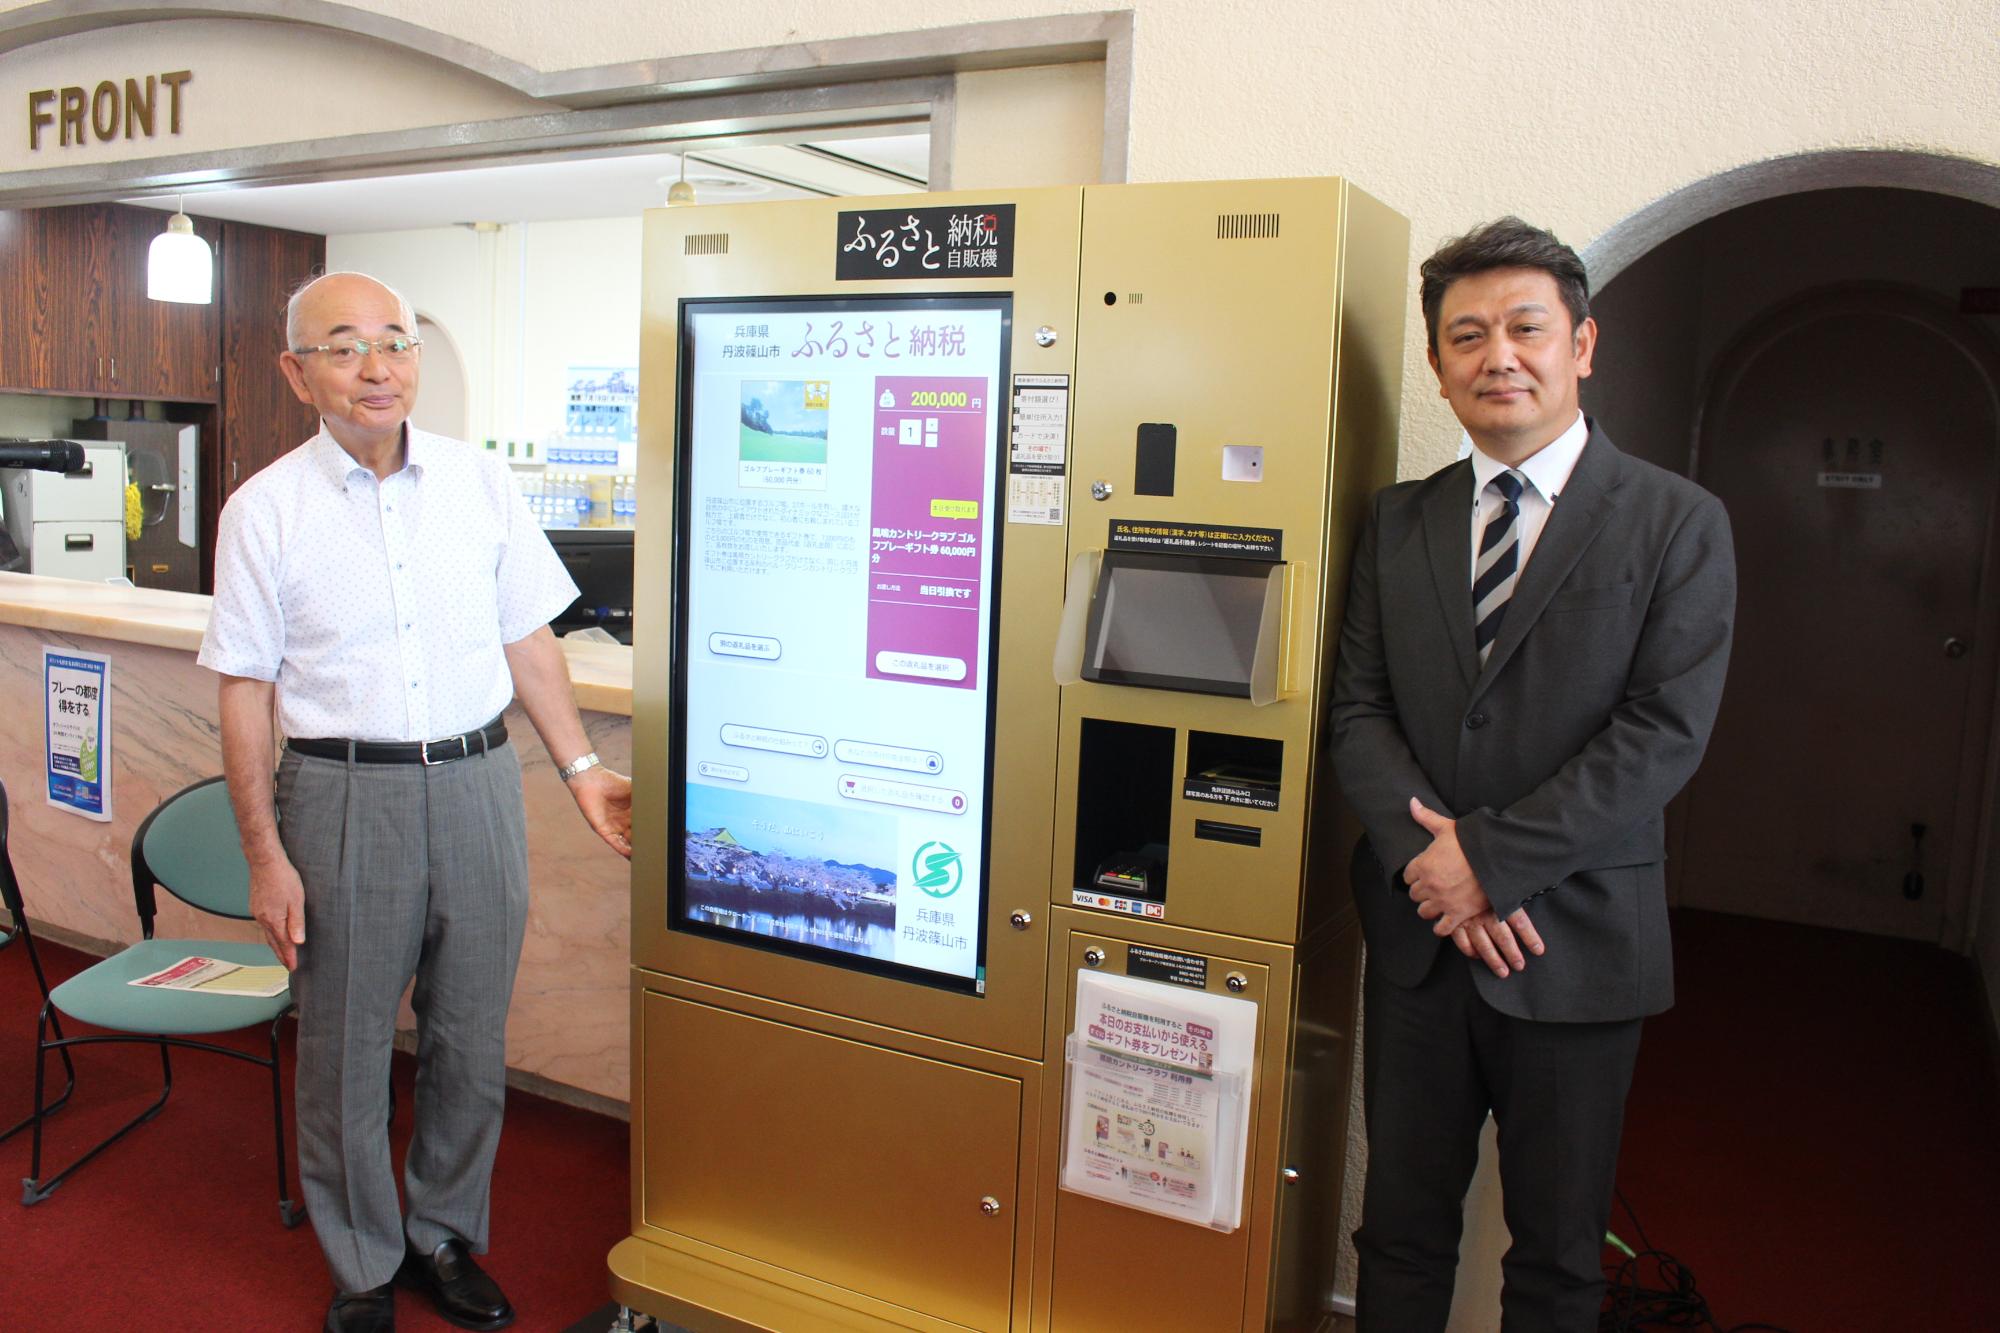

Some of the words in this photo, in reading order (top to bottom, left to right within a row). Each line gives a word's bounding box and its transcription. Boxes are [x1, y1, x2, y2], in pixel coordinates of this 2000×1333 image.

[29, 70, 192, 150] FRONT
[947, 249, 998, 269] 自販機
[734, 325, 769, 339] 兵庫県
[791, 321, 966, 358] ふるさと納税
[721, 344, 781, 359] 丹波篠山市
[911, 391, 967, 408] 200,000
[972, 399, 982, 409] 円
[907, 426, 914, 438] 1
[872, 554, 880, 563] 分
[58, 699, 90, 717] 得をする
[1076, 894, 1093, 904] VISA
[916, 908, 956, 928] 兵庫県
[903, 927, 969, 951] 丹波篠山市
[1099, 1013, 1208, 1052] 本日のお支払いから使える
[1106, 1032, 1198, 1065] ギフト券をプレゼント
